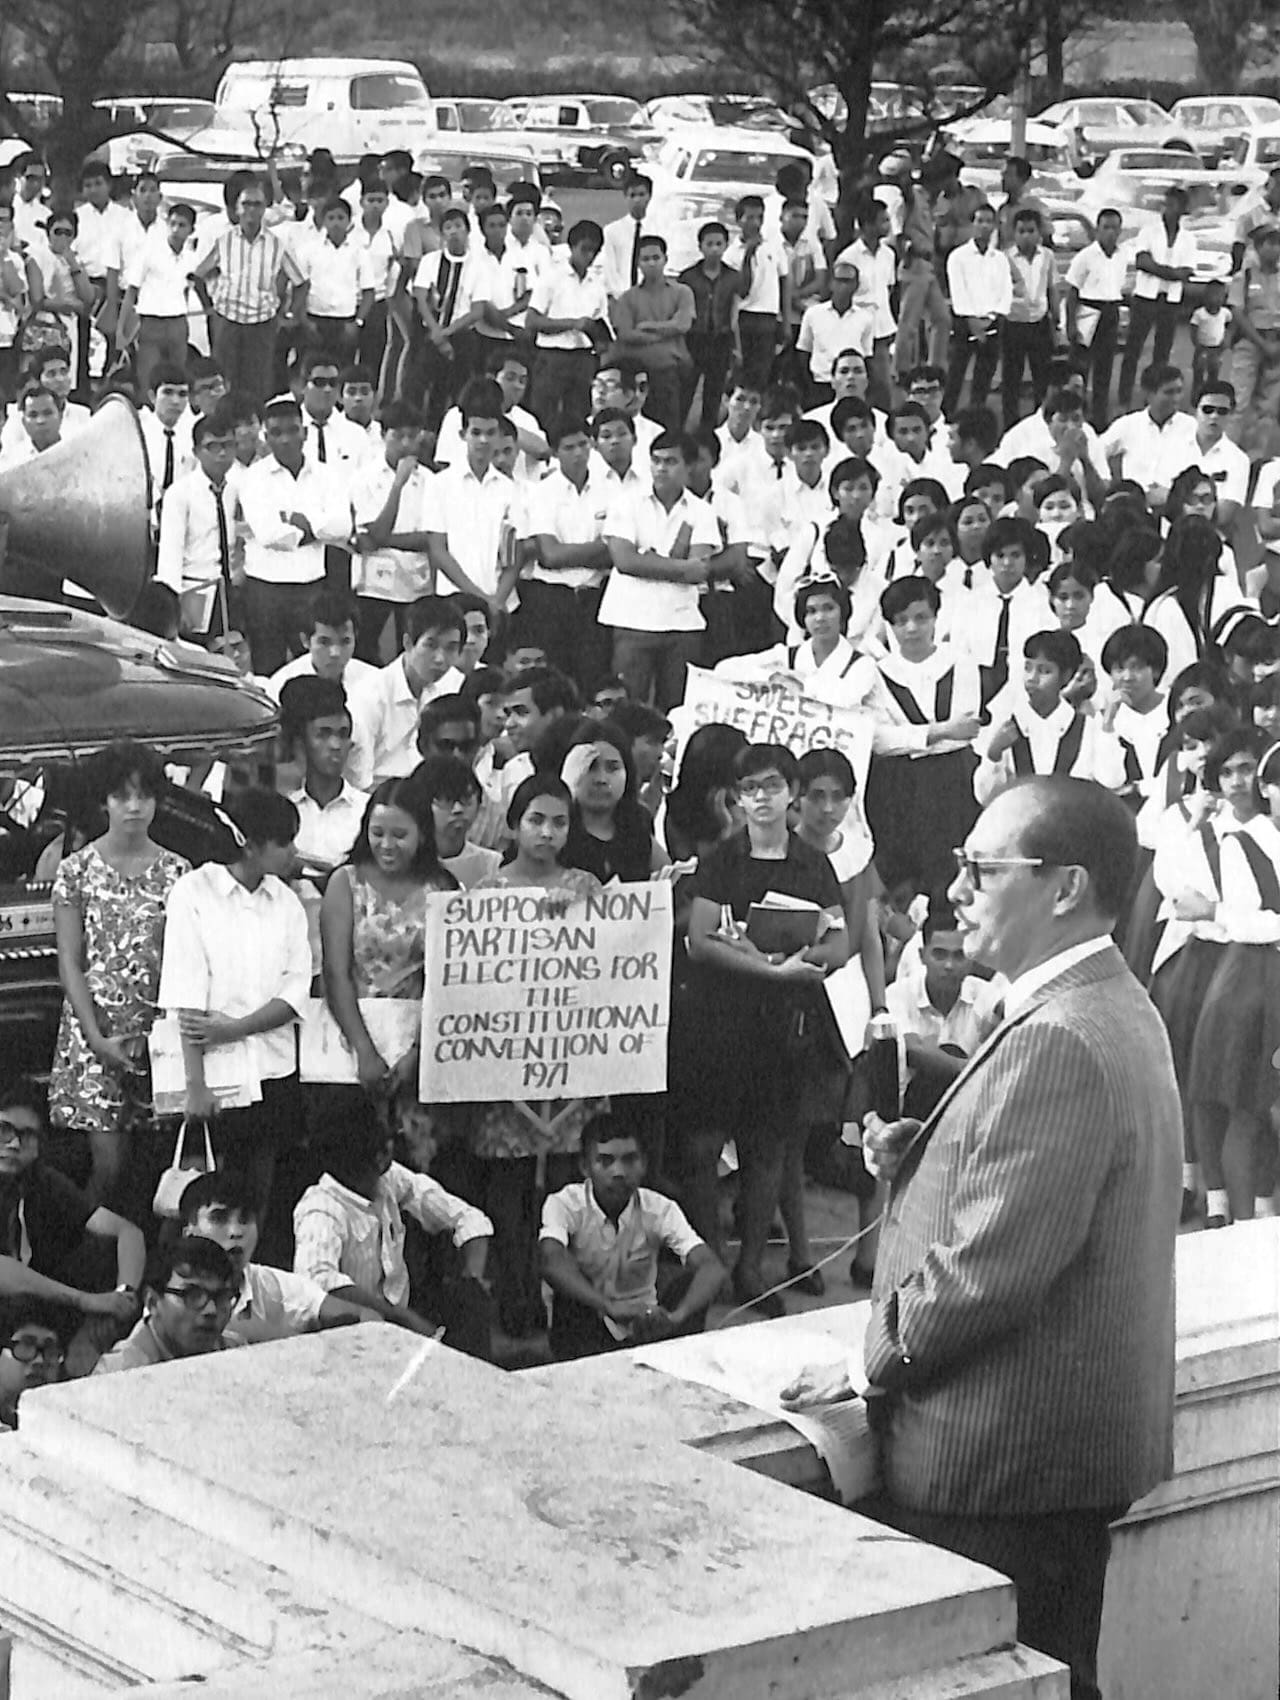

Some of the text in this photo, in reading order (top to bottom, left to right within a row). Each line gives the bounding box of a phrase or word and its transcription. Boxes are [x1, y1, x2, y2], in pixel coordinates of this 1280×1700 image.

[584, 891, 666, 921] NON-
[445, 926, 596, 958] PARTISAN
[442, 952, 659, 986] ELECTIONS FOR
[524, 986, 579, 1007] THE
[437, 1003, 668, 1037] CONSTITUTIONAL
[434, 1032, 655, 1063] CONVENTION OF
[521, 1062, 569, 1089] 1971
